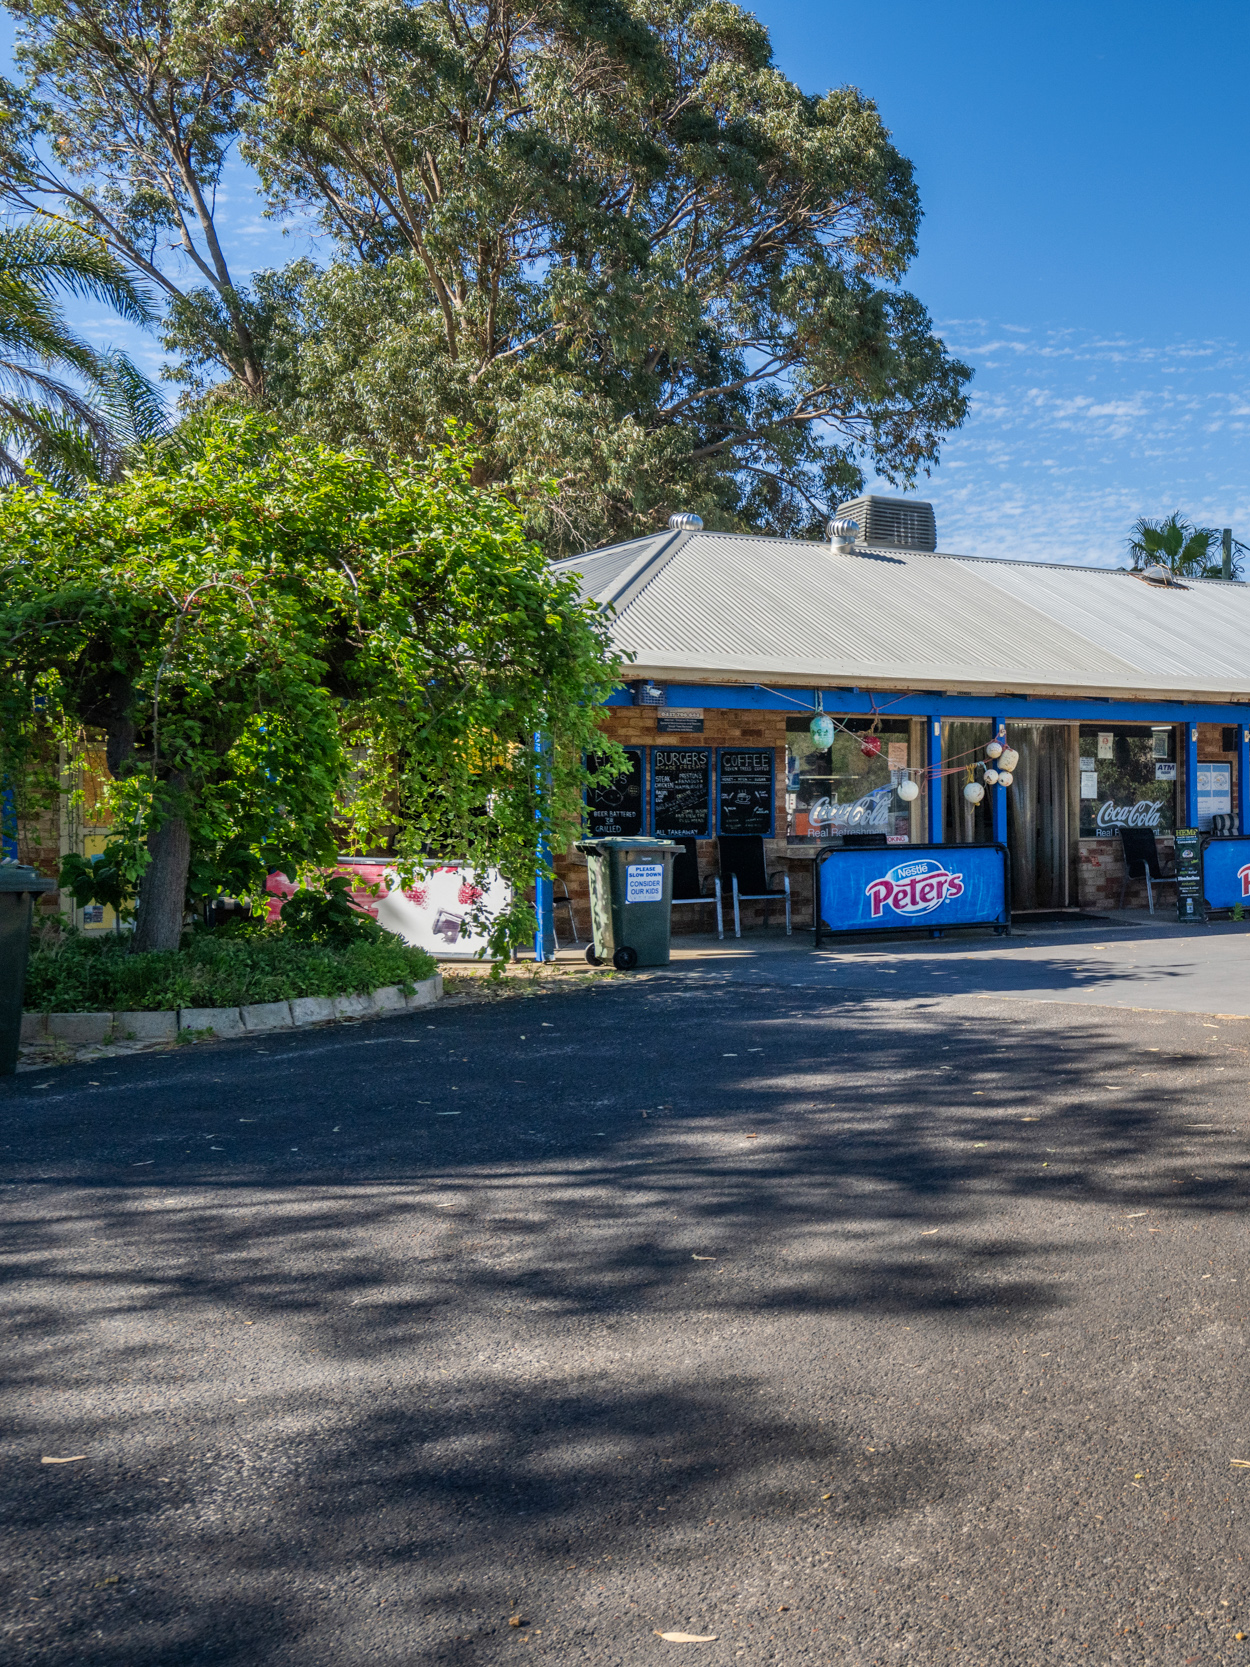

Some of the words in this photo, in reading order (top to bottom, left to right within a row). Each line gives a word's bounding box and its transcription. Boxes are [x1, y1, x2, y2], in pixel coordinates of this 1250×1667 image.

[656, 752, 706, 766] BURGERS
[723, 754, 769, 767] COFFEE
[808, 796, 894, 826] Coca-Cola
[1097, 800, 1164, 828] Coca-Cola
[595, 825, 622, 833] GRILLED
[808, 828, 828, 838] Real
[832, 828, 888, 837] Refreshment
[1096, 829, 1112, 837] Real
[1176, 829, 1198, 837] HEMP
[866, 872, 964, 918] Peters
